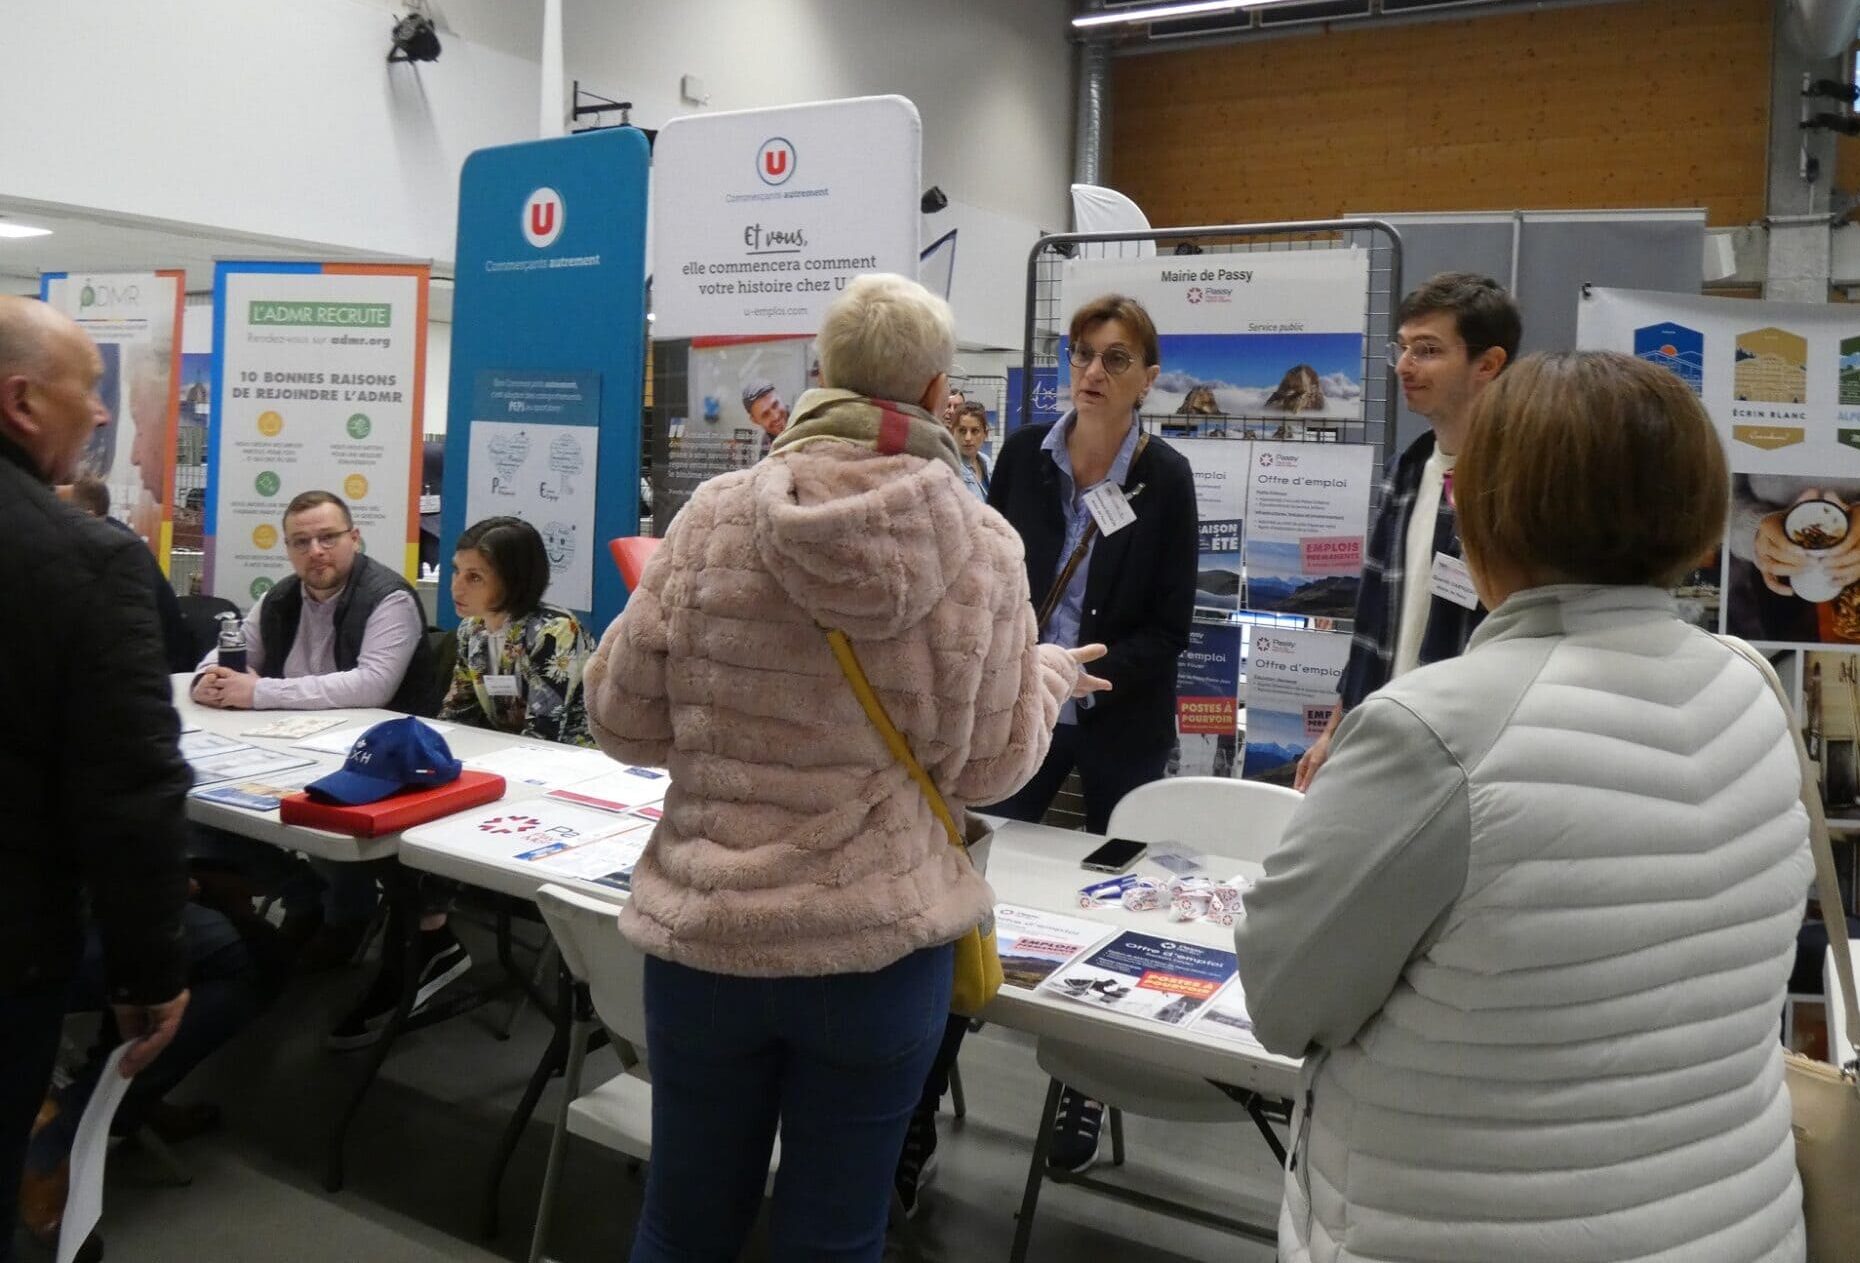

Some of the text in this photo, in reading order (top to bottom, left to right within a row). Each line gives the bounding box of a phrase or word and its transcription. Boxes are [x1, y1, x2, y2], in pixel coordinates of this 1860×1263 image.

[766, 151, 786, 175] U
[784, 188, 829, 199] autrement
[532, 202, 555, 236] U
[744, 223, 808, 250] Et vous,
[549, 255, 601, 269] autrement
[682, 255, 877, 275] elle commencera comment
[1161, 268, 1254, 283] Mairie de Passy
[699, 277, 847, 295] votre histoire chez U
[253, 306, 385, 324] L'ADMR RECRUTE
[1248, 322, 1304, 333] Service public
[331, 334, 391, 349] admr.org
[240, 371, 397, 387] 10 BONNES RAISONS
[232, 387, 402, 404] DE REJOINDRE L'ADMR
[1733, 408, 1806, 420] ÉCRIN BLANC
[1193, 471, 1227, 481] mploi
[1258, 474, 1347, 489] Offre d'emploi
[1211, 533, 1239, 551] ÉTÉ
[1306, 542, 1359, 553] EMPLOIS
[1255, 659, 1286, 670] Offre
[1181, 701, 1233, 713] POSTES À
[1182, 715, 1233, 723] POURVOIR
[1125, 942, 1160, 954] Offre
